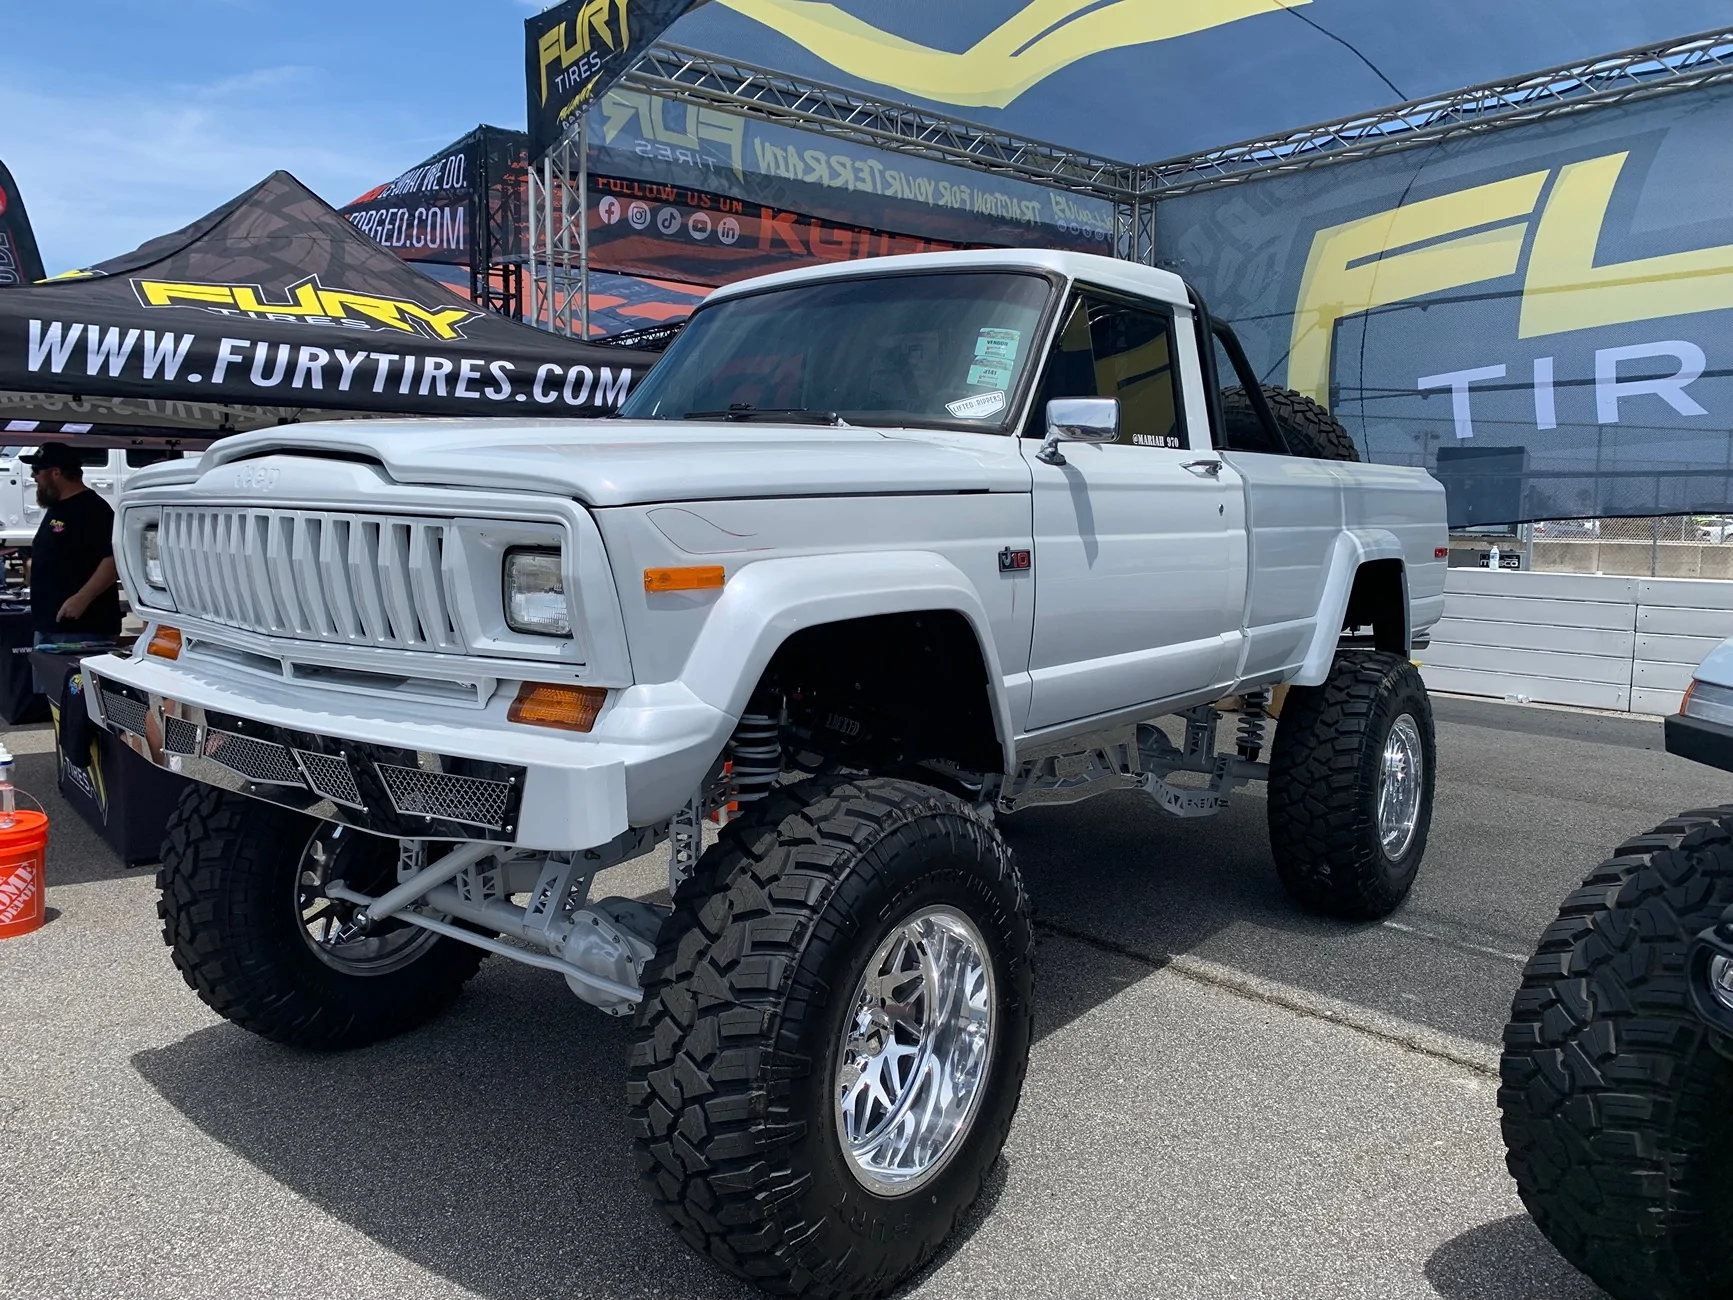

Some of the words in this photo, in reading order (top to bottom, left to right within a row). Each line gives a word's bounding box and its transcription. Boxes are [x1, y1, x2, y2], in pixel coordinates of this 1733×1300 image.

[539, 0, 629, 108] FURY
[554, 51, 601, 94] TIRES
[443, 153, 467, 189] DO.
[597, 177, 678, 202] FOLLOW
[686, 190, 711, 208] US
[141, 281, 469, 339] FURY
[27, 319, 632, 408] WWW.FURYTIRES.COM
[986, 339, 1009, 347] VENDOR
[952, 401, 974, 413] LIFTED
[975, 394, 1002, 406] RIPPERS
[1418, 339, 1709, 440] TIR
[1480, 559, 1519, 567] msco
[64, 756, 90, 791] TIRES
[0, 867, 33, 911] OME
[0, 881, 36, 924] DEPOT
